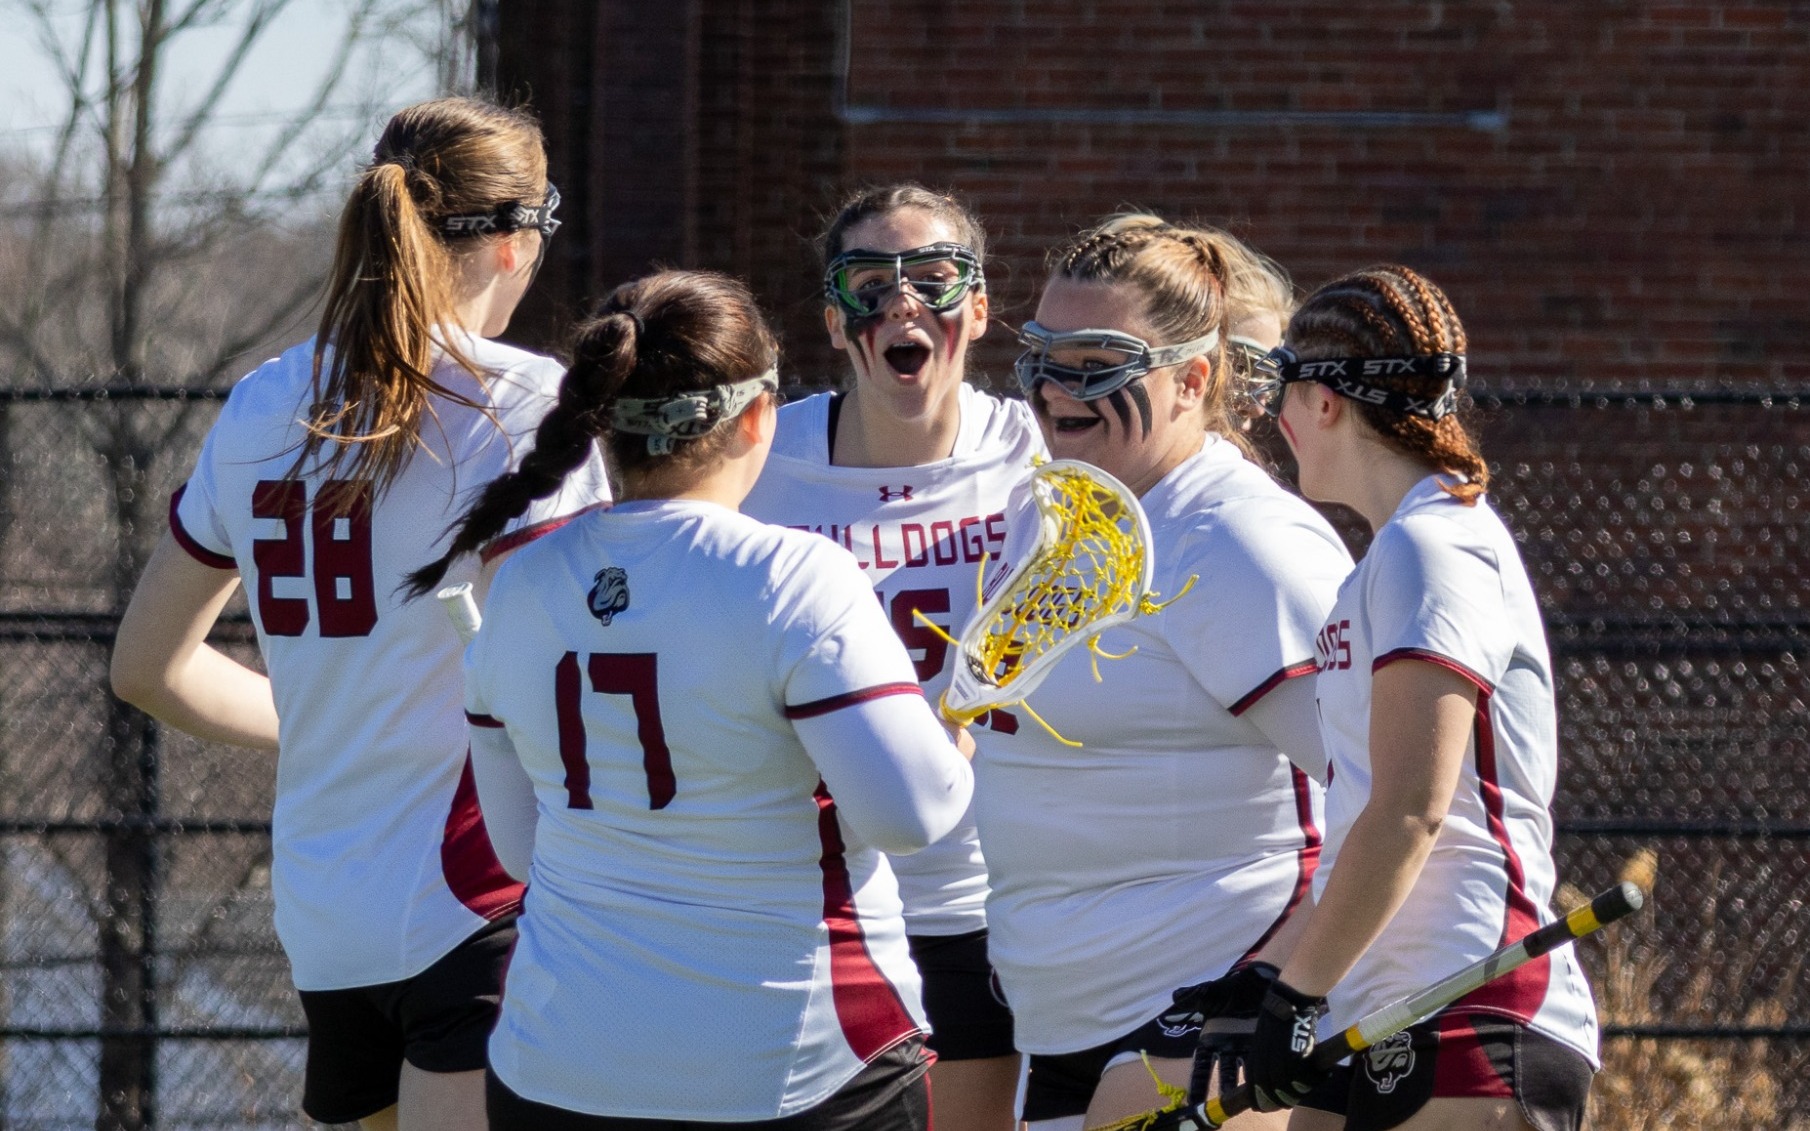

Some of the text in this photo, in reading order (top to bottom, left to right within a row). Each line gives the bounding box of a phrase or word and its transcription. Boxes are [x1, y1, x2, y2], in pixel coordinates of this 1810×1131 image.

[446, 215, 496, 230] STX
[1299, 358, 1416, 378] STX STX
[1336, 378, 1389, 405] STX
[252, 480, 378, 637] 28
[787, 513, 1006, 569] LLDOGS
[875, 588, 950, 682] 5
[555, 651, 676, 810] 17
[1291, 1014, 1311, 1052] STX
